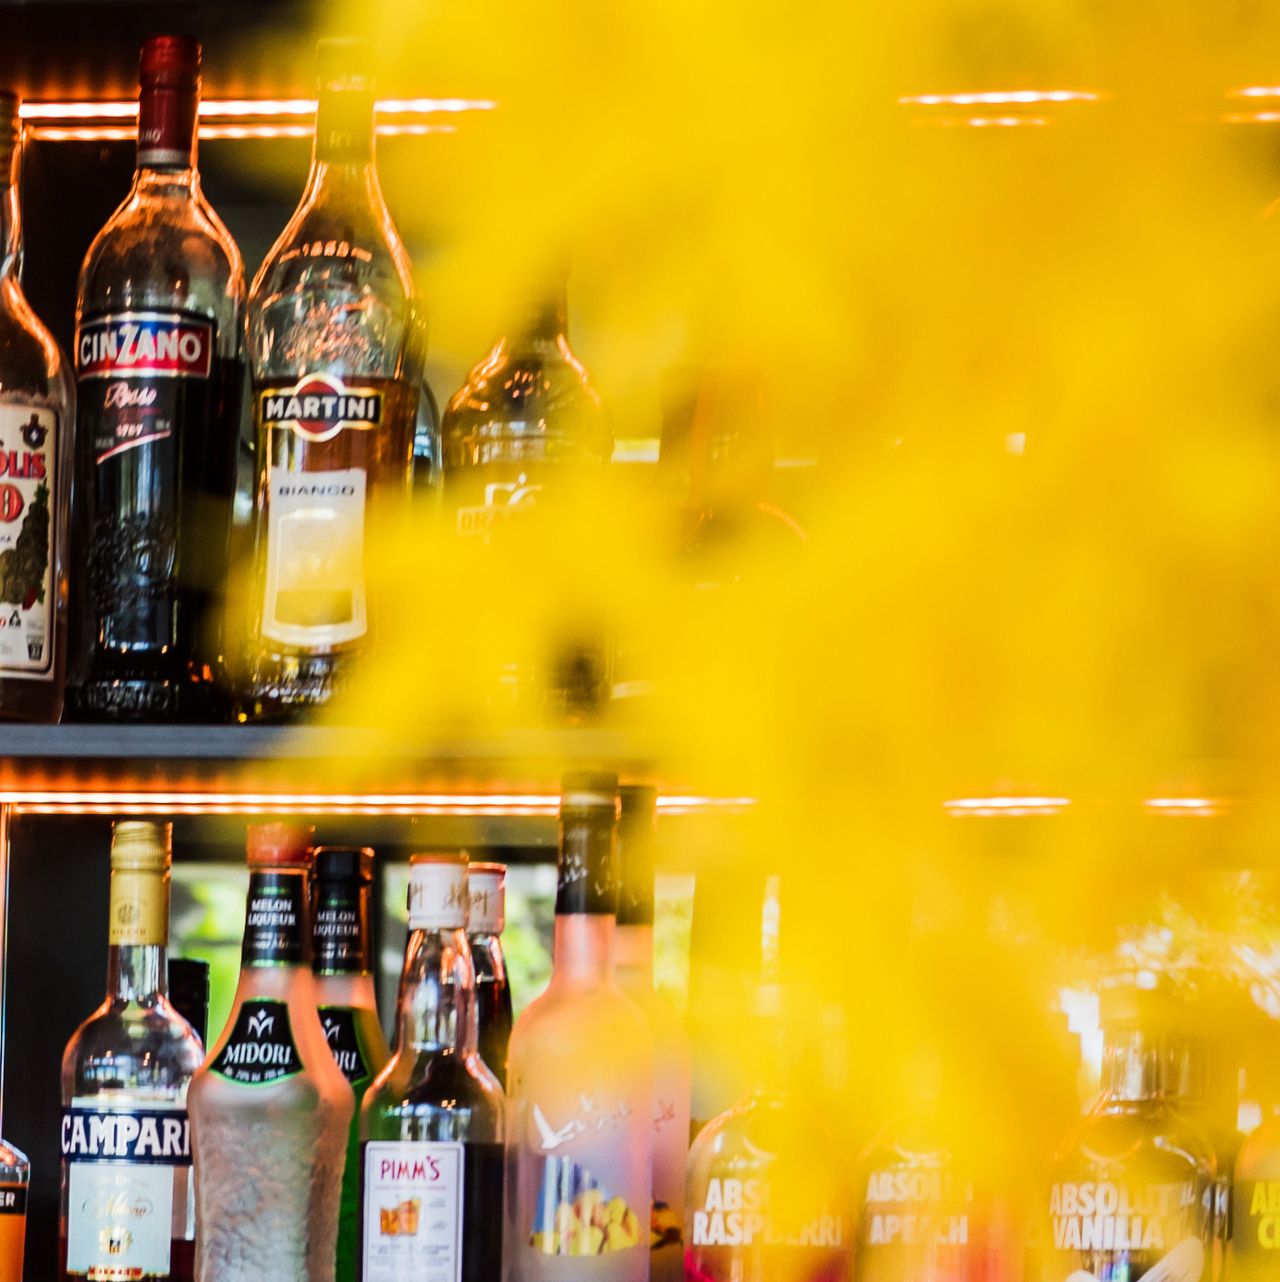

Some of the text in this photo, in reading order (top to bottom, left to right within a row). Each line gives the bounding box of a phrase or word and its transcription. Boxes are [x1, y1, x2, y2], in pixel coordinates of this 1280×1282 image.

[81, 323, 201, 365] CINZANO
[266, 395, 375, 420] MARTINI
[278, 485, 355, 497] BIANCO
[251, 899, 292, 911] MELON
[317, 911, 356, 922] MELON
[248, 912, 295, 925] LIQUEUR
[314, 924, 359, 936] LIQUEUR
[223, 1043, 291, 1065] MIDORI
[61, 1114, 190, 1156] CAMPARI
[380, 1157, 441, 1181] PIMM'S
[1049, 1182, 1171, 1216] ABSOLUT
[1052, 1216, 1165, 1250] VANILIA
